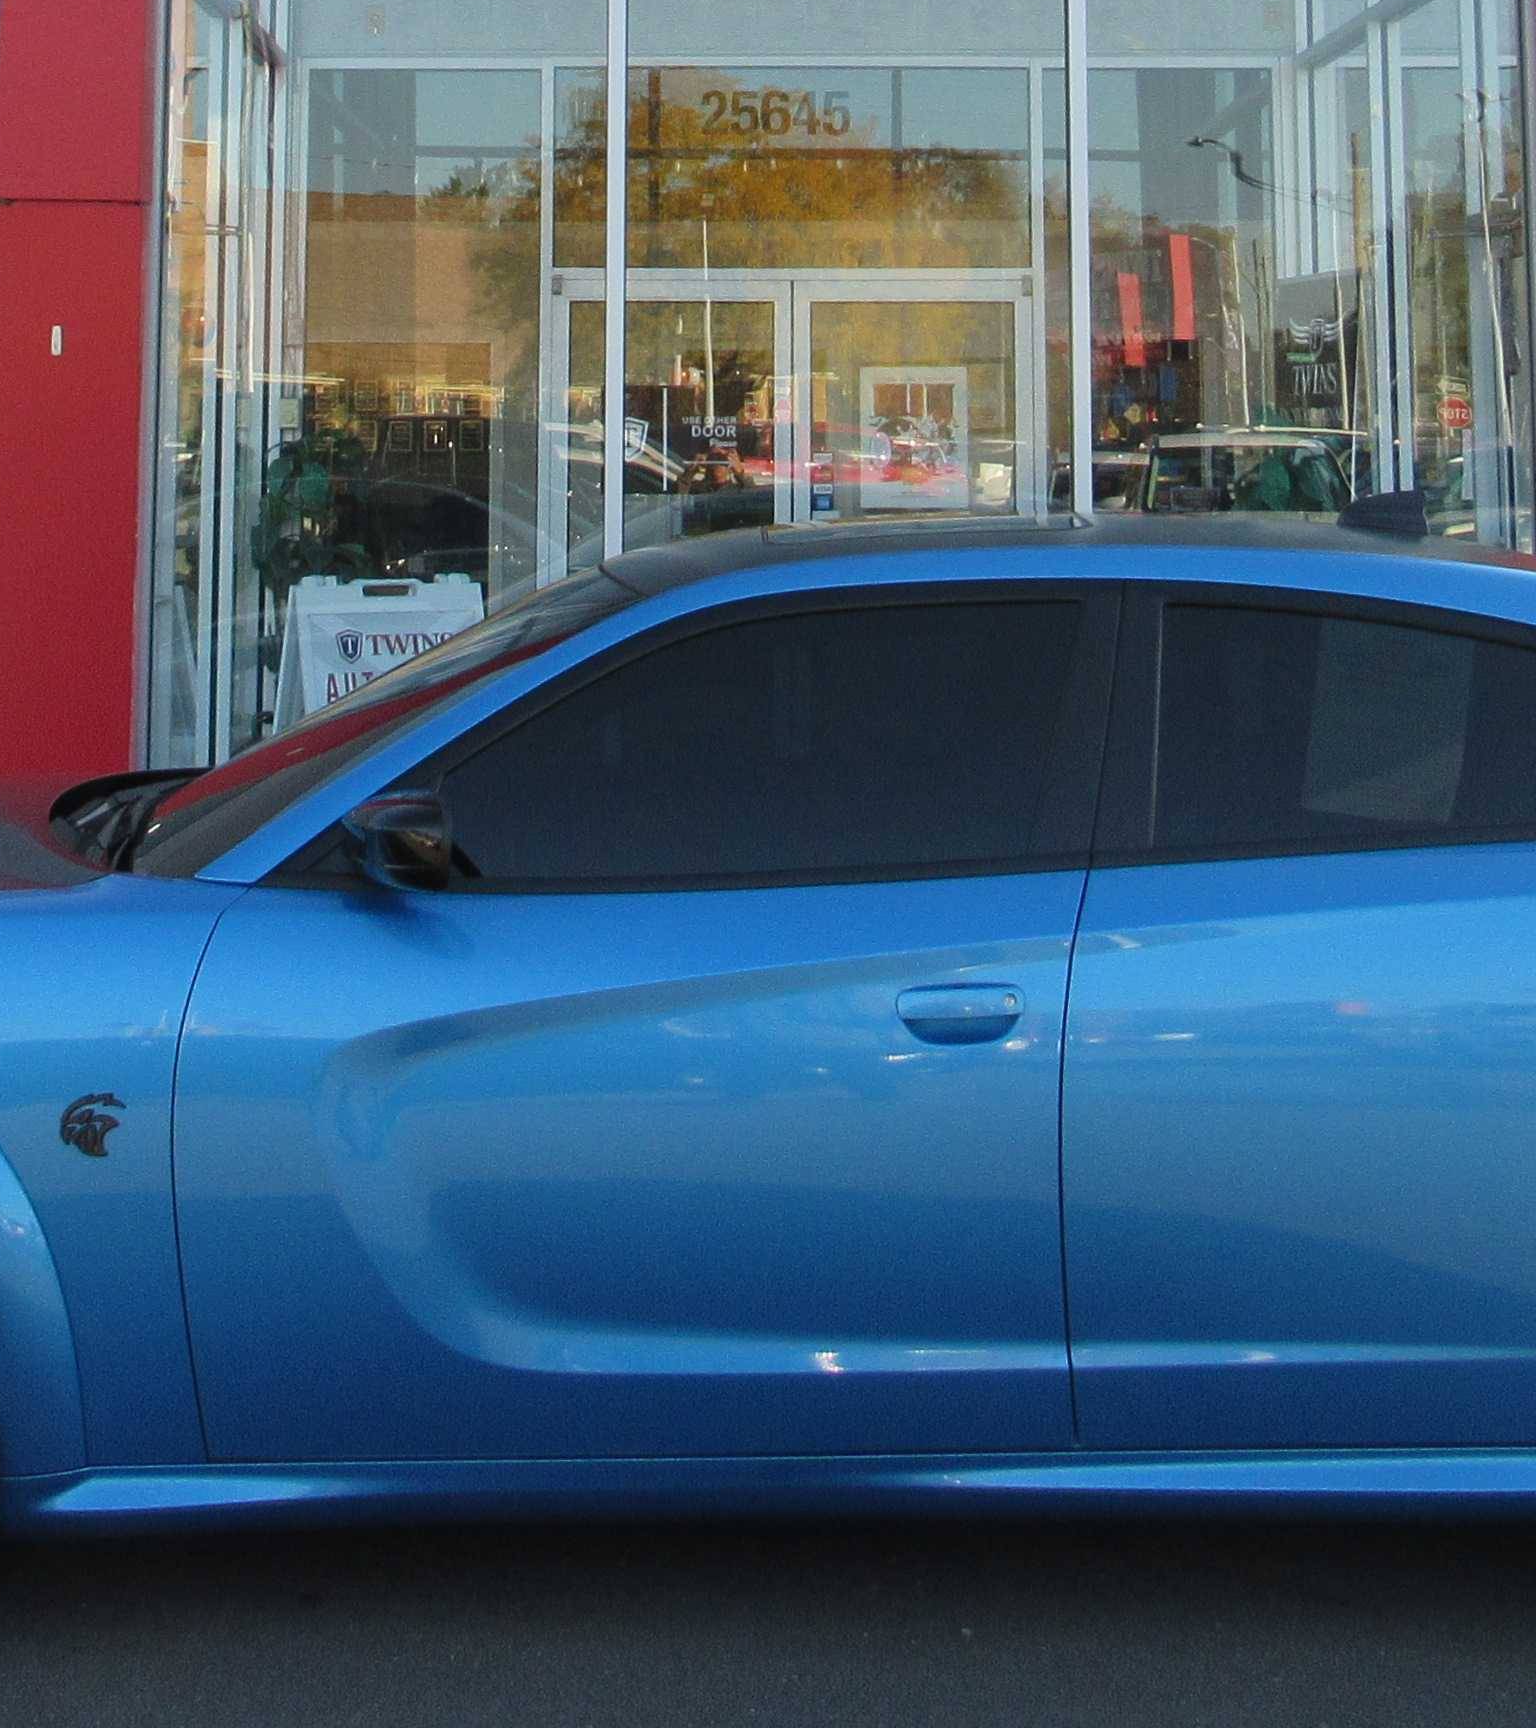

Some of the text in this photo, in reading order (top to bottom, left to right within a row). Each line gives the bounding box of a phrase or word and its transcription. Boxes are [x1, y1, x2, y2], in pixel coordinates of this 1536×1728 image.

[701, 88, 852, 137] 25645
[1292, 363, 1338, 396] TWINS
[690, 424, 737, 438] DOOR
[326, 671, 374, 704] AU
